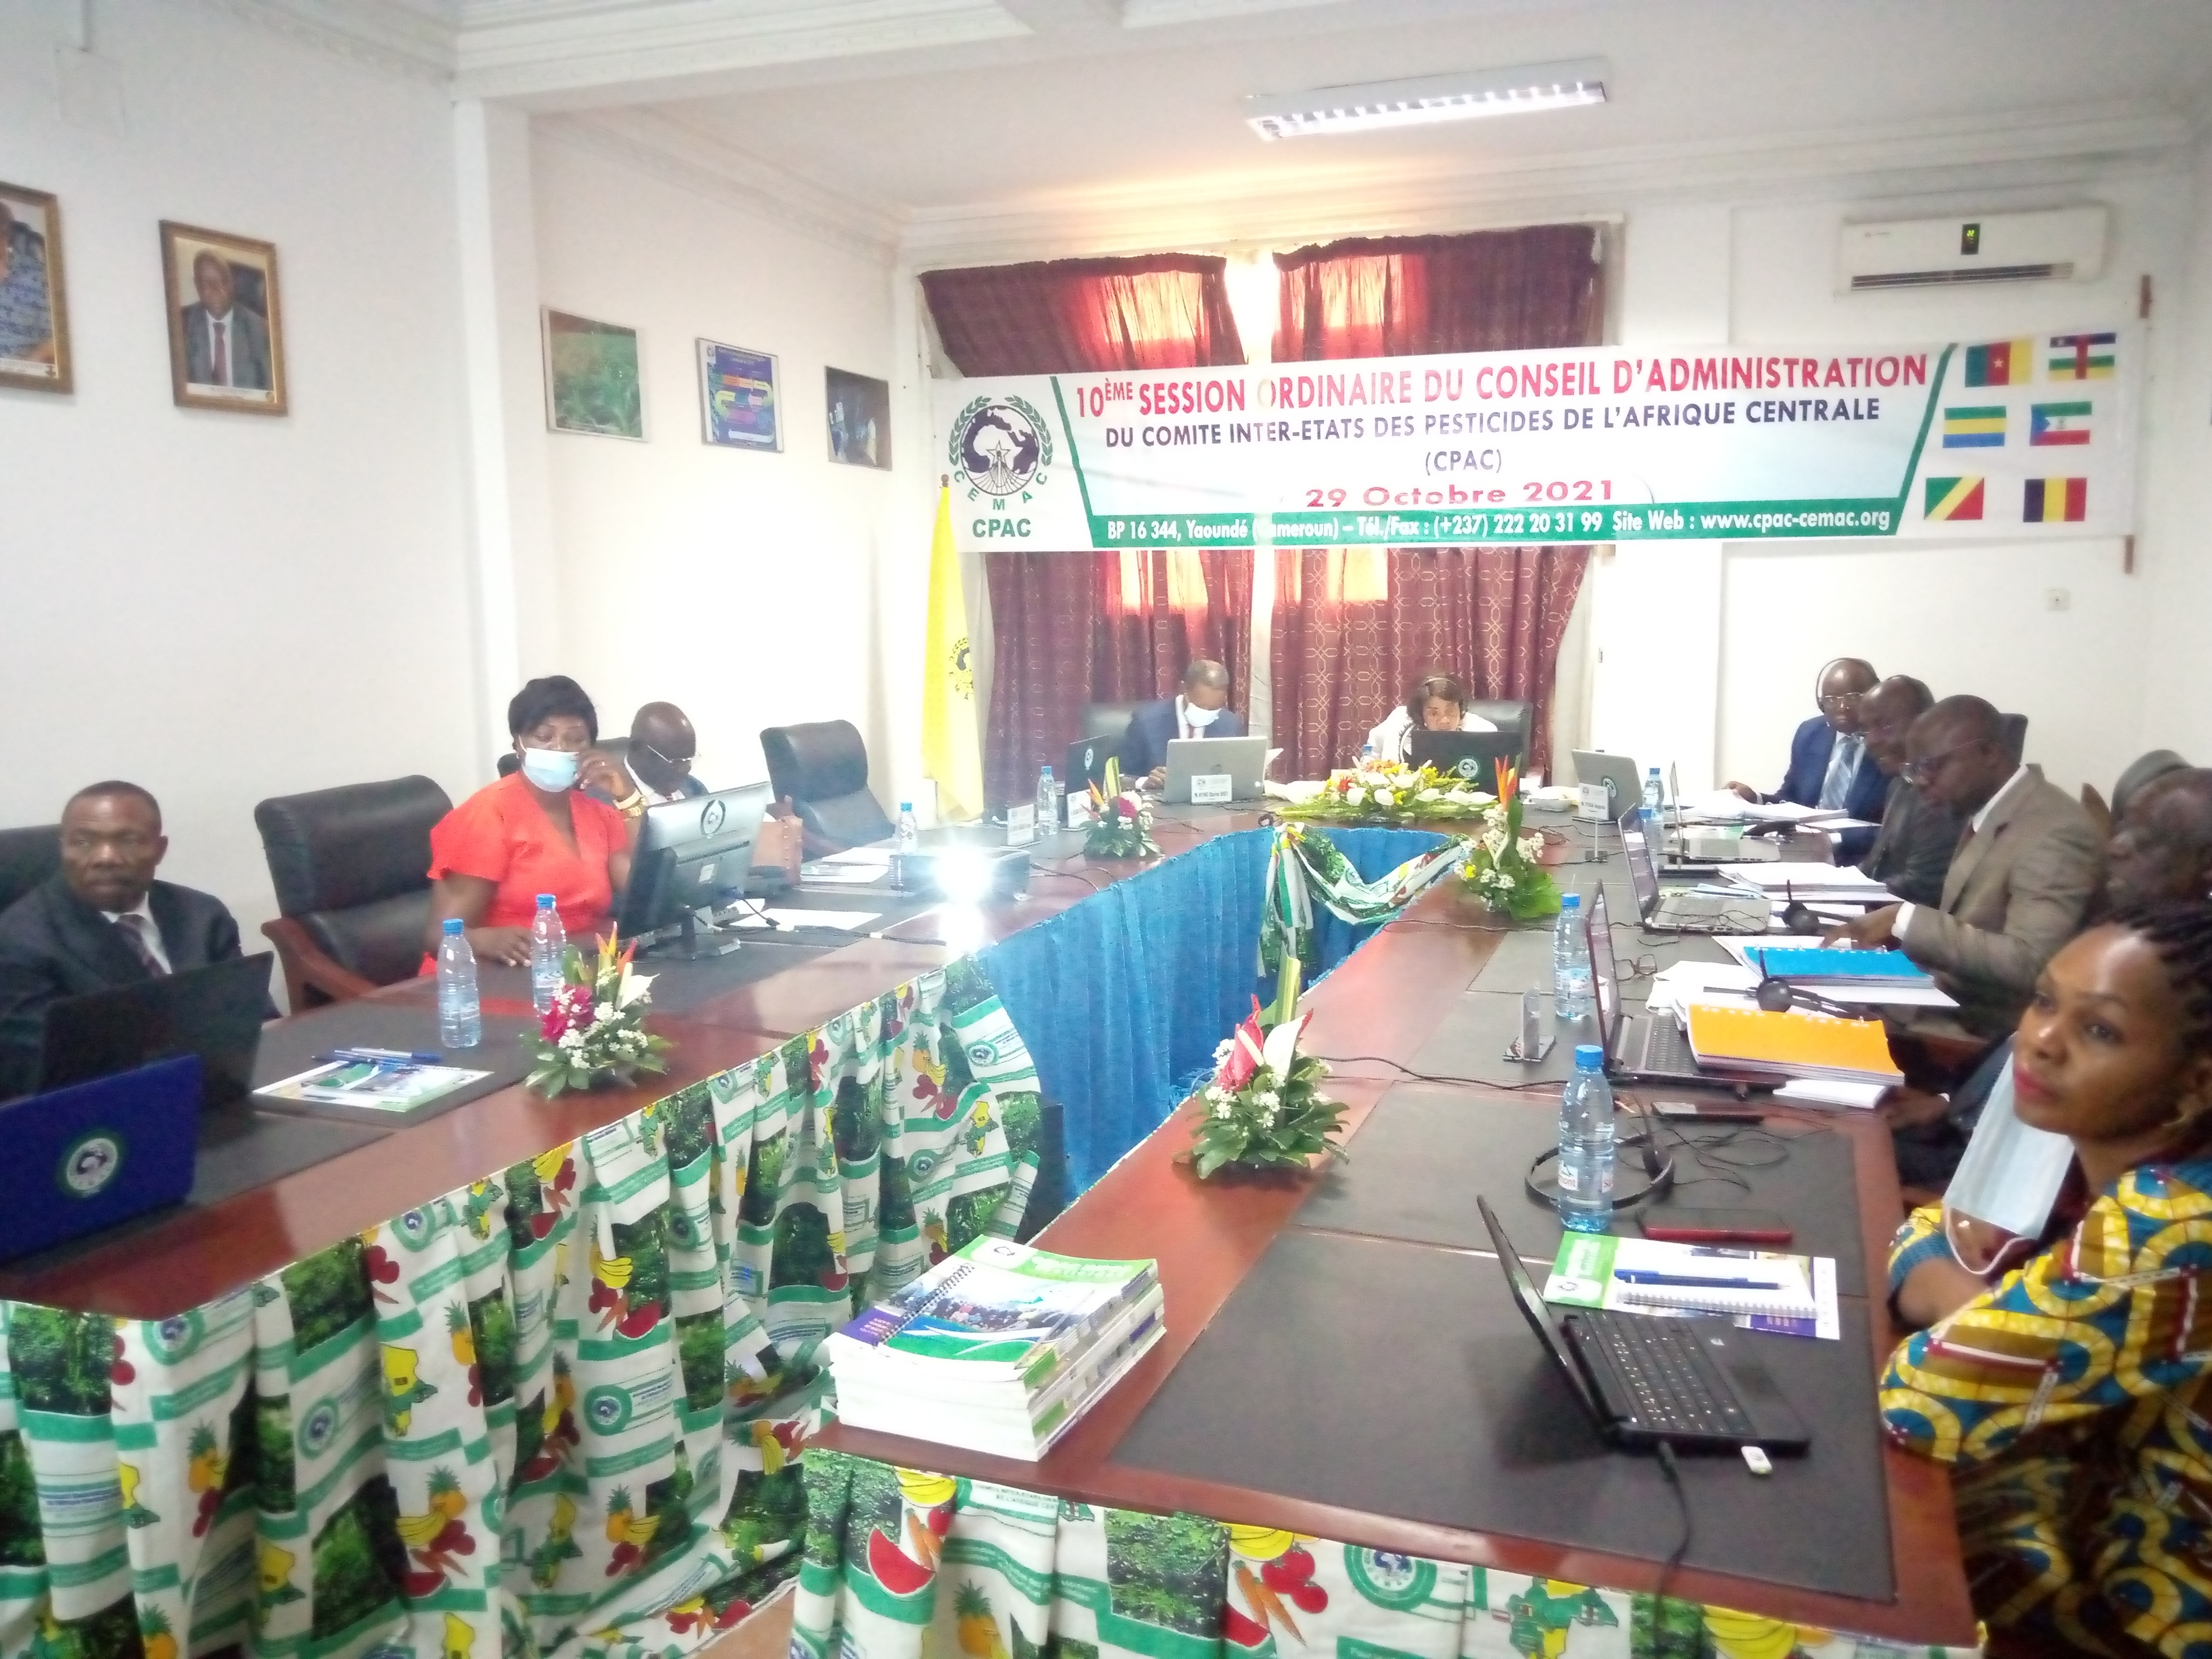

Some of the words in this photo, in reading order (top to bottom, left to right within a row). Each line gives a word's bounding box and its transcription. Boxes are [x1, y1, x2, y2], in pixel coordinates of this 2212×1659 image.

[1140, 380, 1245, 416] SESSION
[1257, 371, 1411, 409] ORDINAIRE
[1426, 369, 1463, 403] DU
[1477, 362, 1601, 400] CONSEIL
[1614, 354, 1926, 393] D'ADMINISTRATION
[1106, 428, 1133, 448] DU
[1143, 425, 1221, 447] COMITE
[1230, 417, 1364, 443] INTER-ETATS
[1376, 416, 1414, 438] DES
[1426, 410, 1553, 435] PESTICIDES
[1565, 409, 1594, 430] DE
[1605, 403, 1736, 428] L'AFRIQUE
[1747, 399, 1880, 423] CENTRALE
[1426, 450, 1502, 476] (CPAC)
[954, 470, 1048, 510] CEMAC
[1307, 489, 1347, 507] 29
[1364, 485, 1506, 506] Octobre
[1524, 481, 1611, 501] 2021
[972, 518, 1031, 538] CPAC
[1109, 522, 1126, 539] BP
[1131, 522, 1147, 539] 16
[1152, 521, 1182, 542] 344,
[1186, 520, 1249, 539] Yaoundé
[1358, 516, 1420, 541] Tél./Fax
[1435, 515, 1488, 539] (+237)
[1494, 514, 1524, 534] 222
[1530, 513, 1551, 533] 20
[1555, 512, 1574, 532] 31
[1581, 512, 1603, 532] 99
[1613, 510, 1643, 531] Site
[1649, 510, 1685, 530] Web
[1701, 510, 1891, 532] www.cpac-cemac.org
